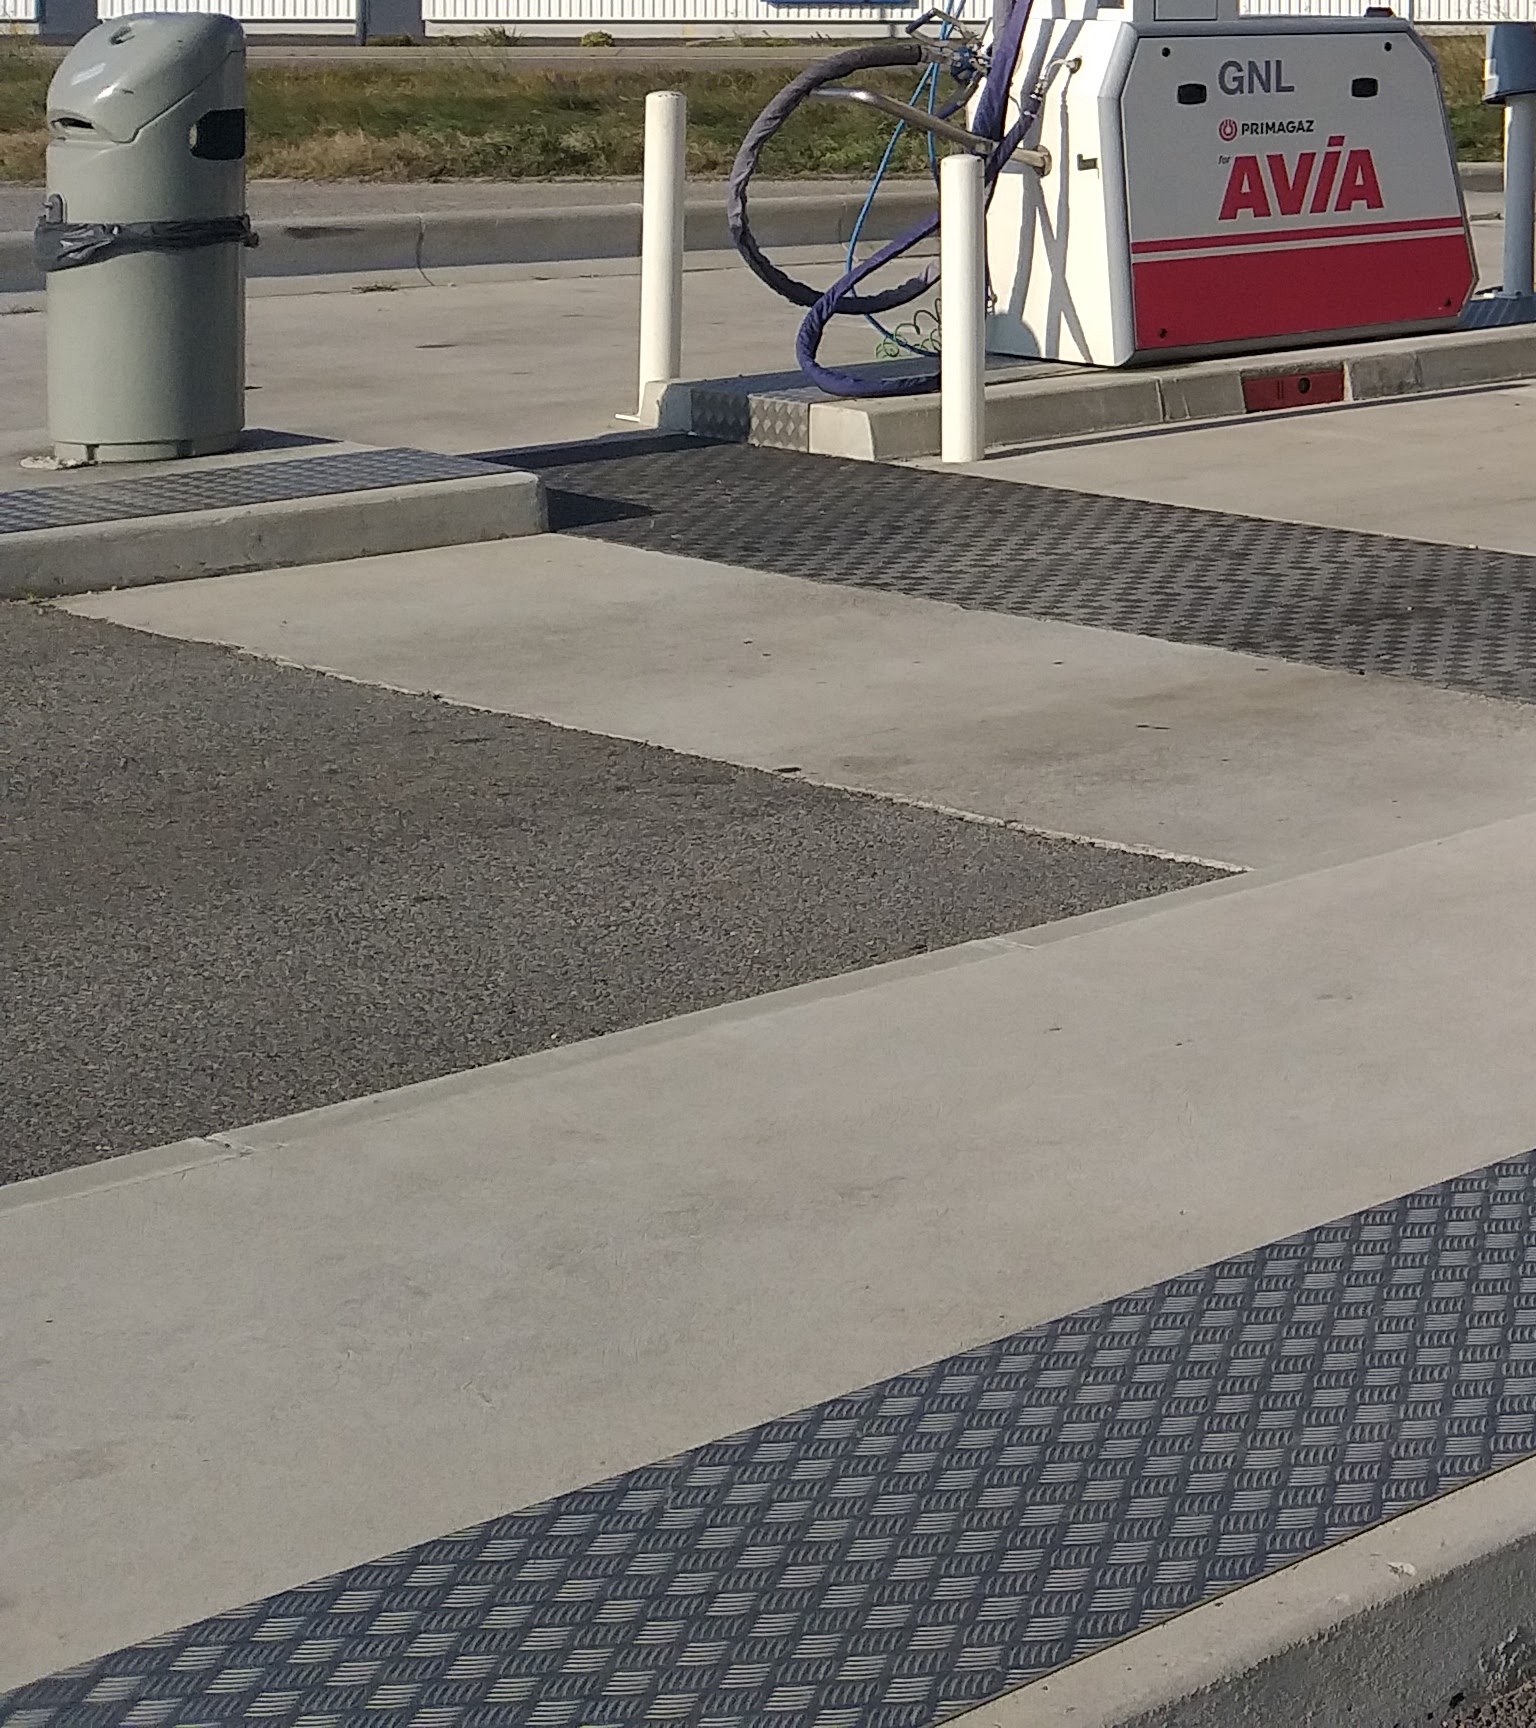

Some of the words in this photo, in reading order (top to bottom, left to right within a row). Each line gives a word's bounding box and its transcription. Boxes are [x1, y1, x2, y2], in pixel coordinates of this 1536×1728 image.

[1218, 60, 1295, 96] GNL
[1241, 120, 1315, 136] PRIMAGAZ
[1218, 135, 1385, 221] AVIA
